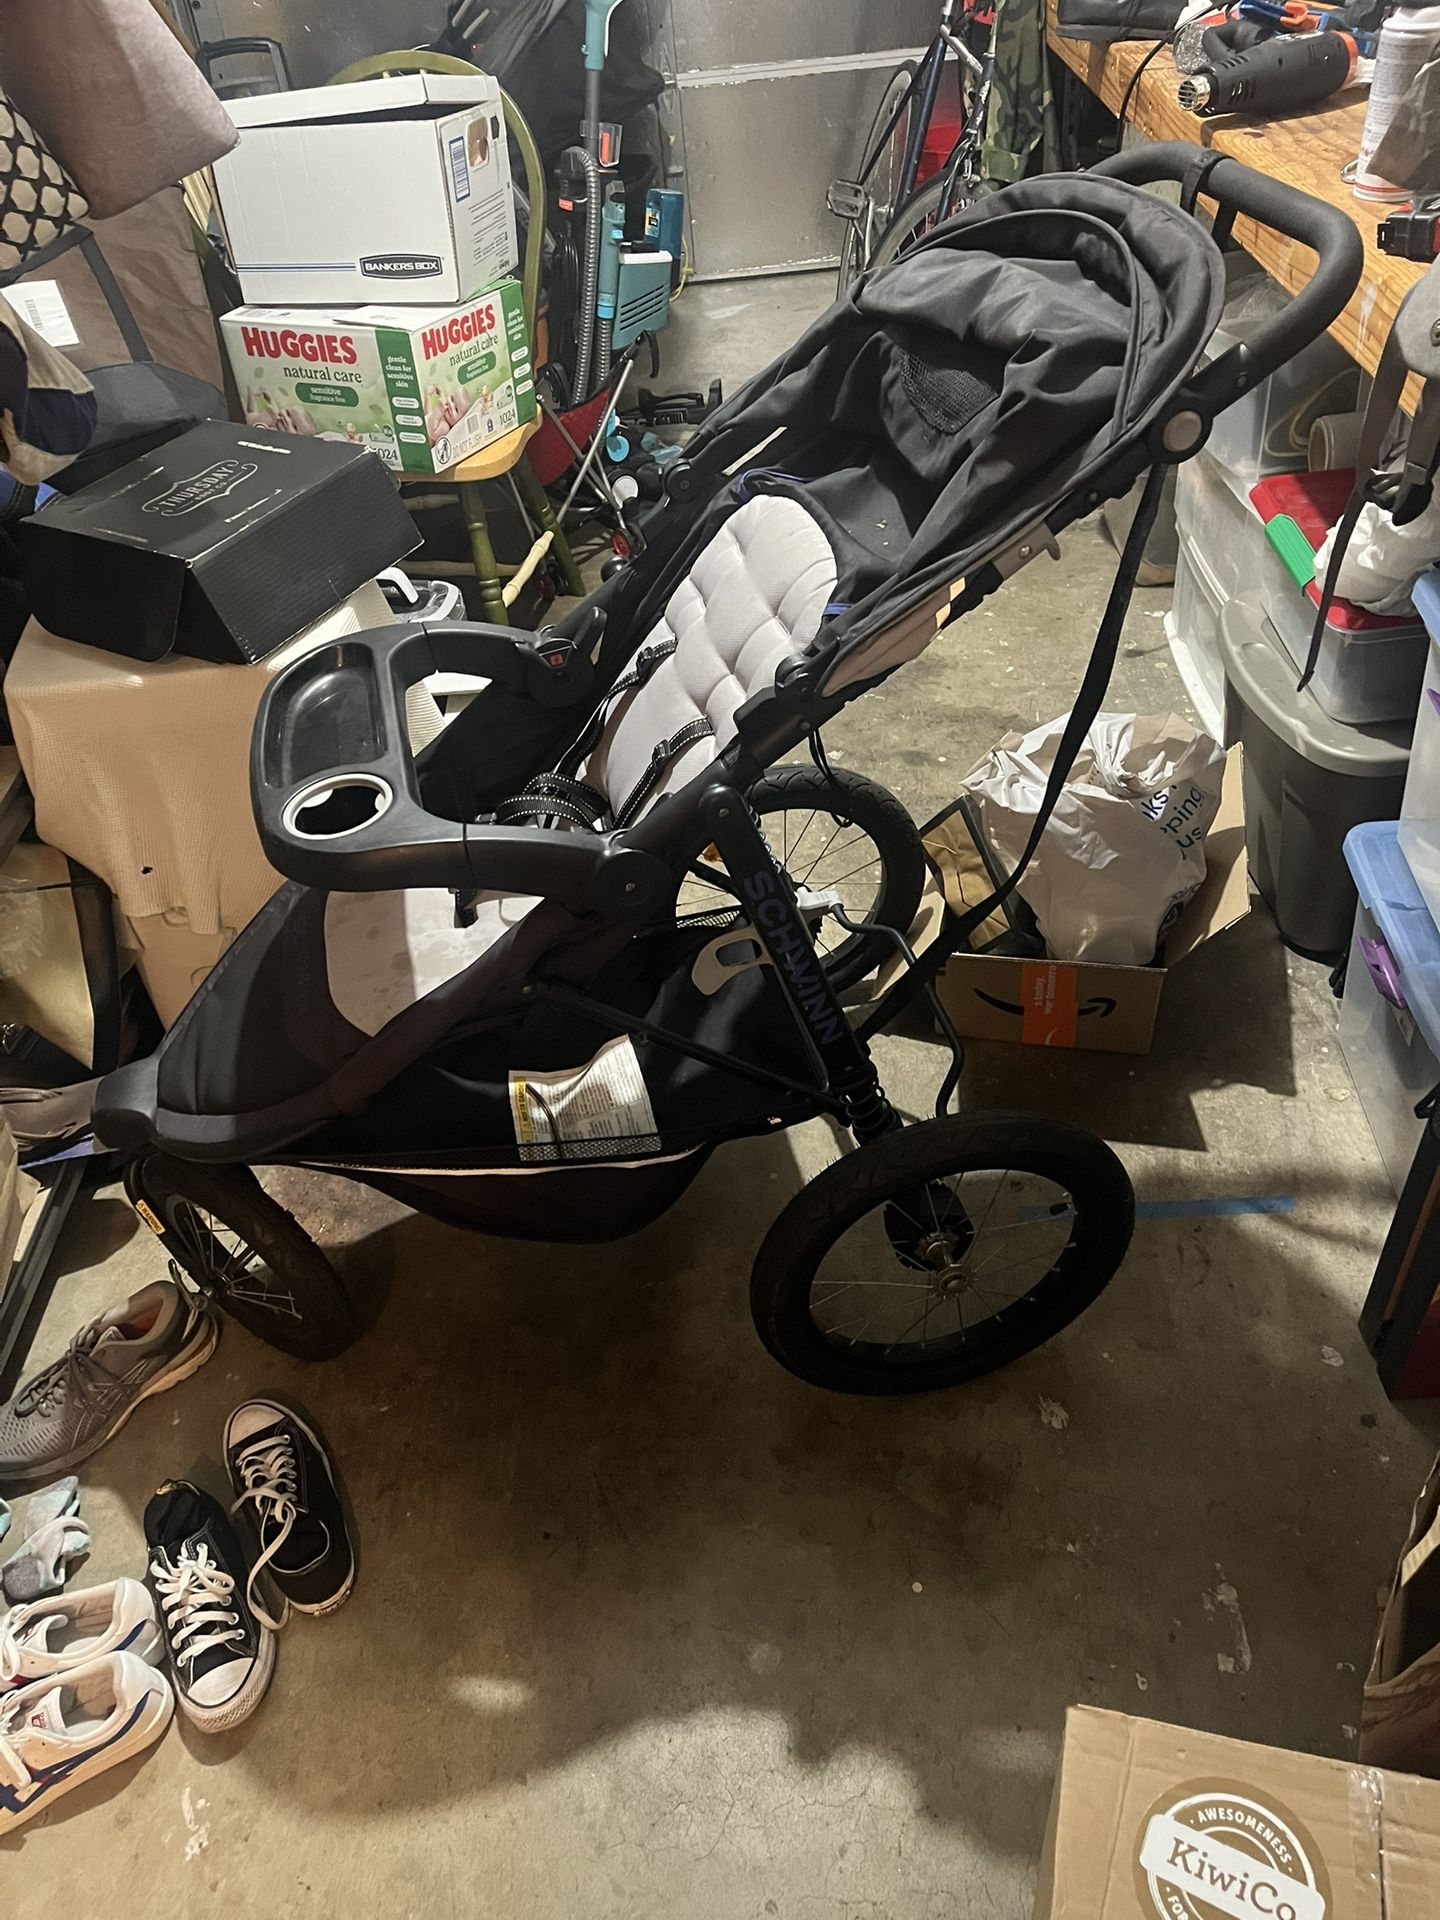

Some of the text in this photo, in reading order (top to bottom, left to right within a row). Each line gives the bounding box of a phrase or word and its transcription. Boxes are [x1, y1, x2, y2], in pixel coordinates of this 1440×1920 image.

[364, 261, 439, 272] BANKERS BOX
[241, 326, 358, 365] HUGGIES
[421, 303, 496, 361] HUGGIES
[449, 334, 499, 367] natural care
[283, 366, 362, 383] natural care
[385, 363, 402, 371] clean
[395, 380, 409, 388] skin
[499, 408, 516, 425] 1024
[374, 446, 398, 461] 024
[159, 466, 235, 507] THURSDAY
[743, 870, 846, 1046] SCHWINN
[142, 1207, 162, 1232] WARNING
[1197, 1807, 1293, 1864] AWESOMENESS
[1166, 1836, 1297, 1920] KiwiCo
